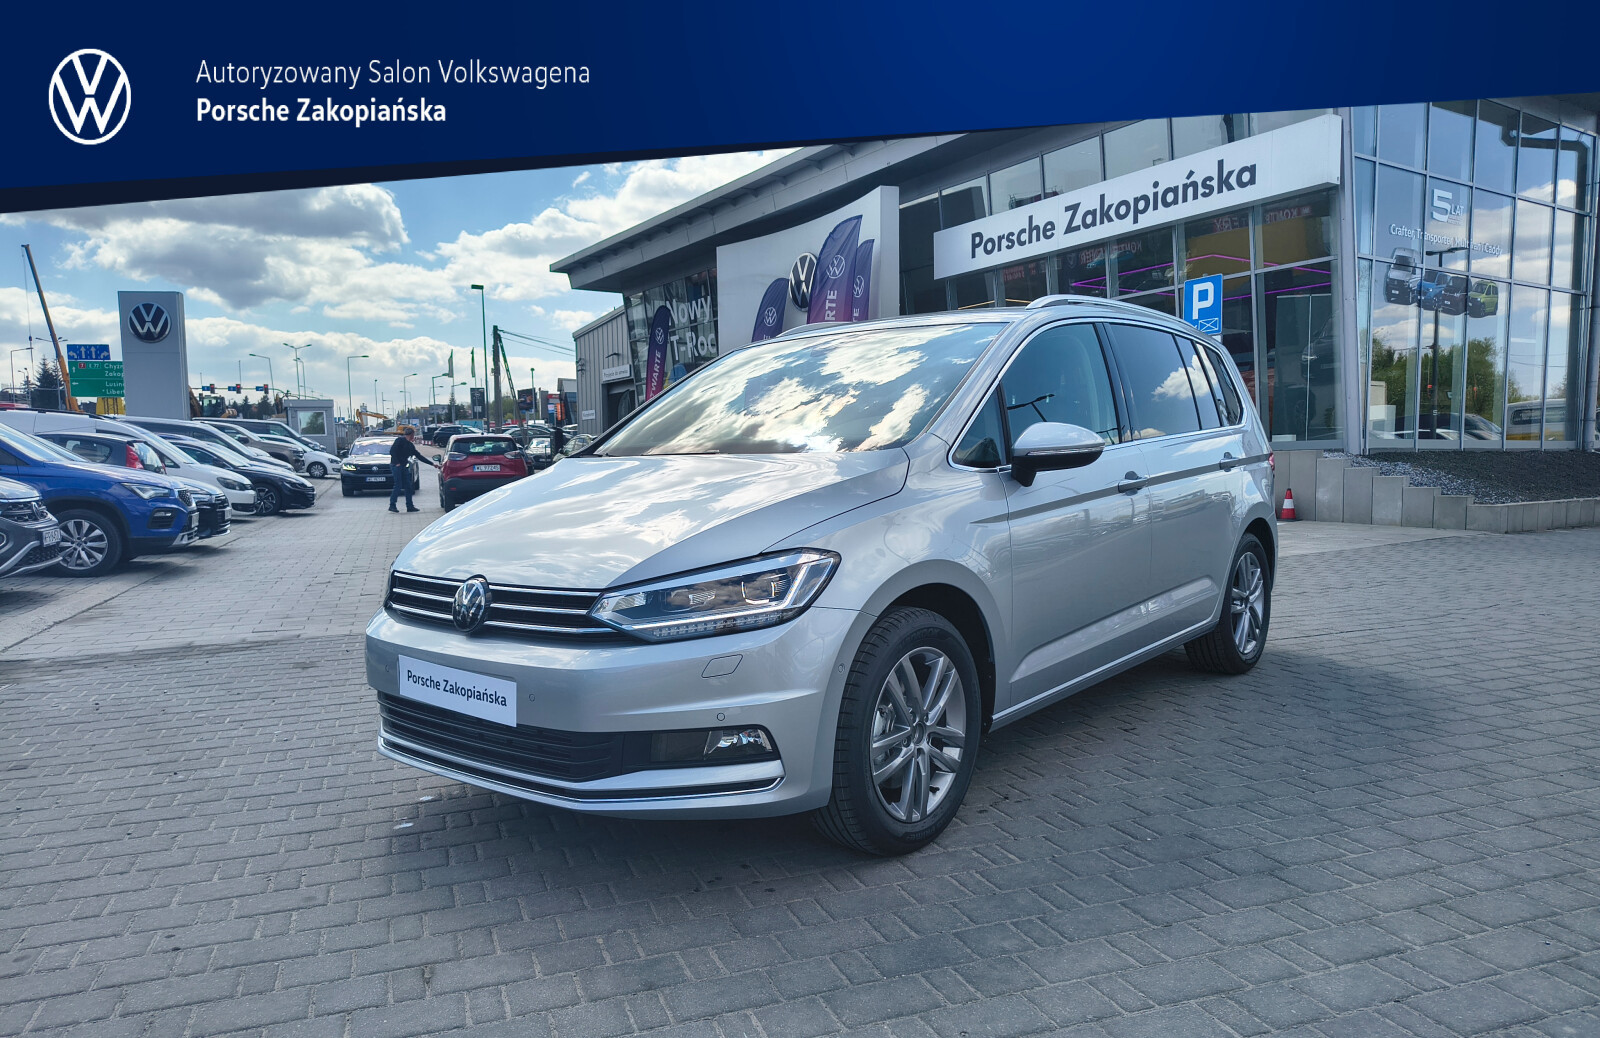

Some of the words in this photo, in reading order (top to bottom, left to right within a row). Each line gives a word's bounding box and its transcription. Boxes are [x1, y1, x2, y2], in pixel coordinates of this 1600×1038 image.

[970, 215, 1056, 259] Porsche
[1063, 158, 1257, 235] Zakopiańska
[666, 295, 711, 326] Nowy
[1192, 281, 1215, 320] P
[670, 331, 717, 361] T-Roc
[407, 669, 441, 691] Porsche
[443, 678, 508, 707] Zakopiańska
